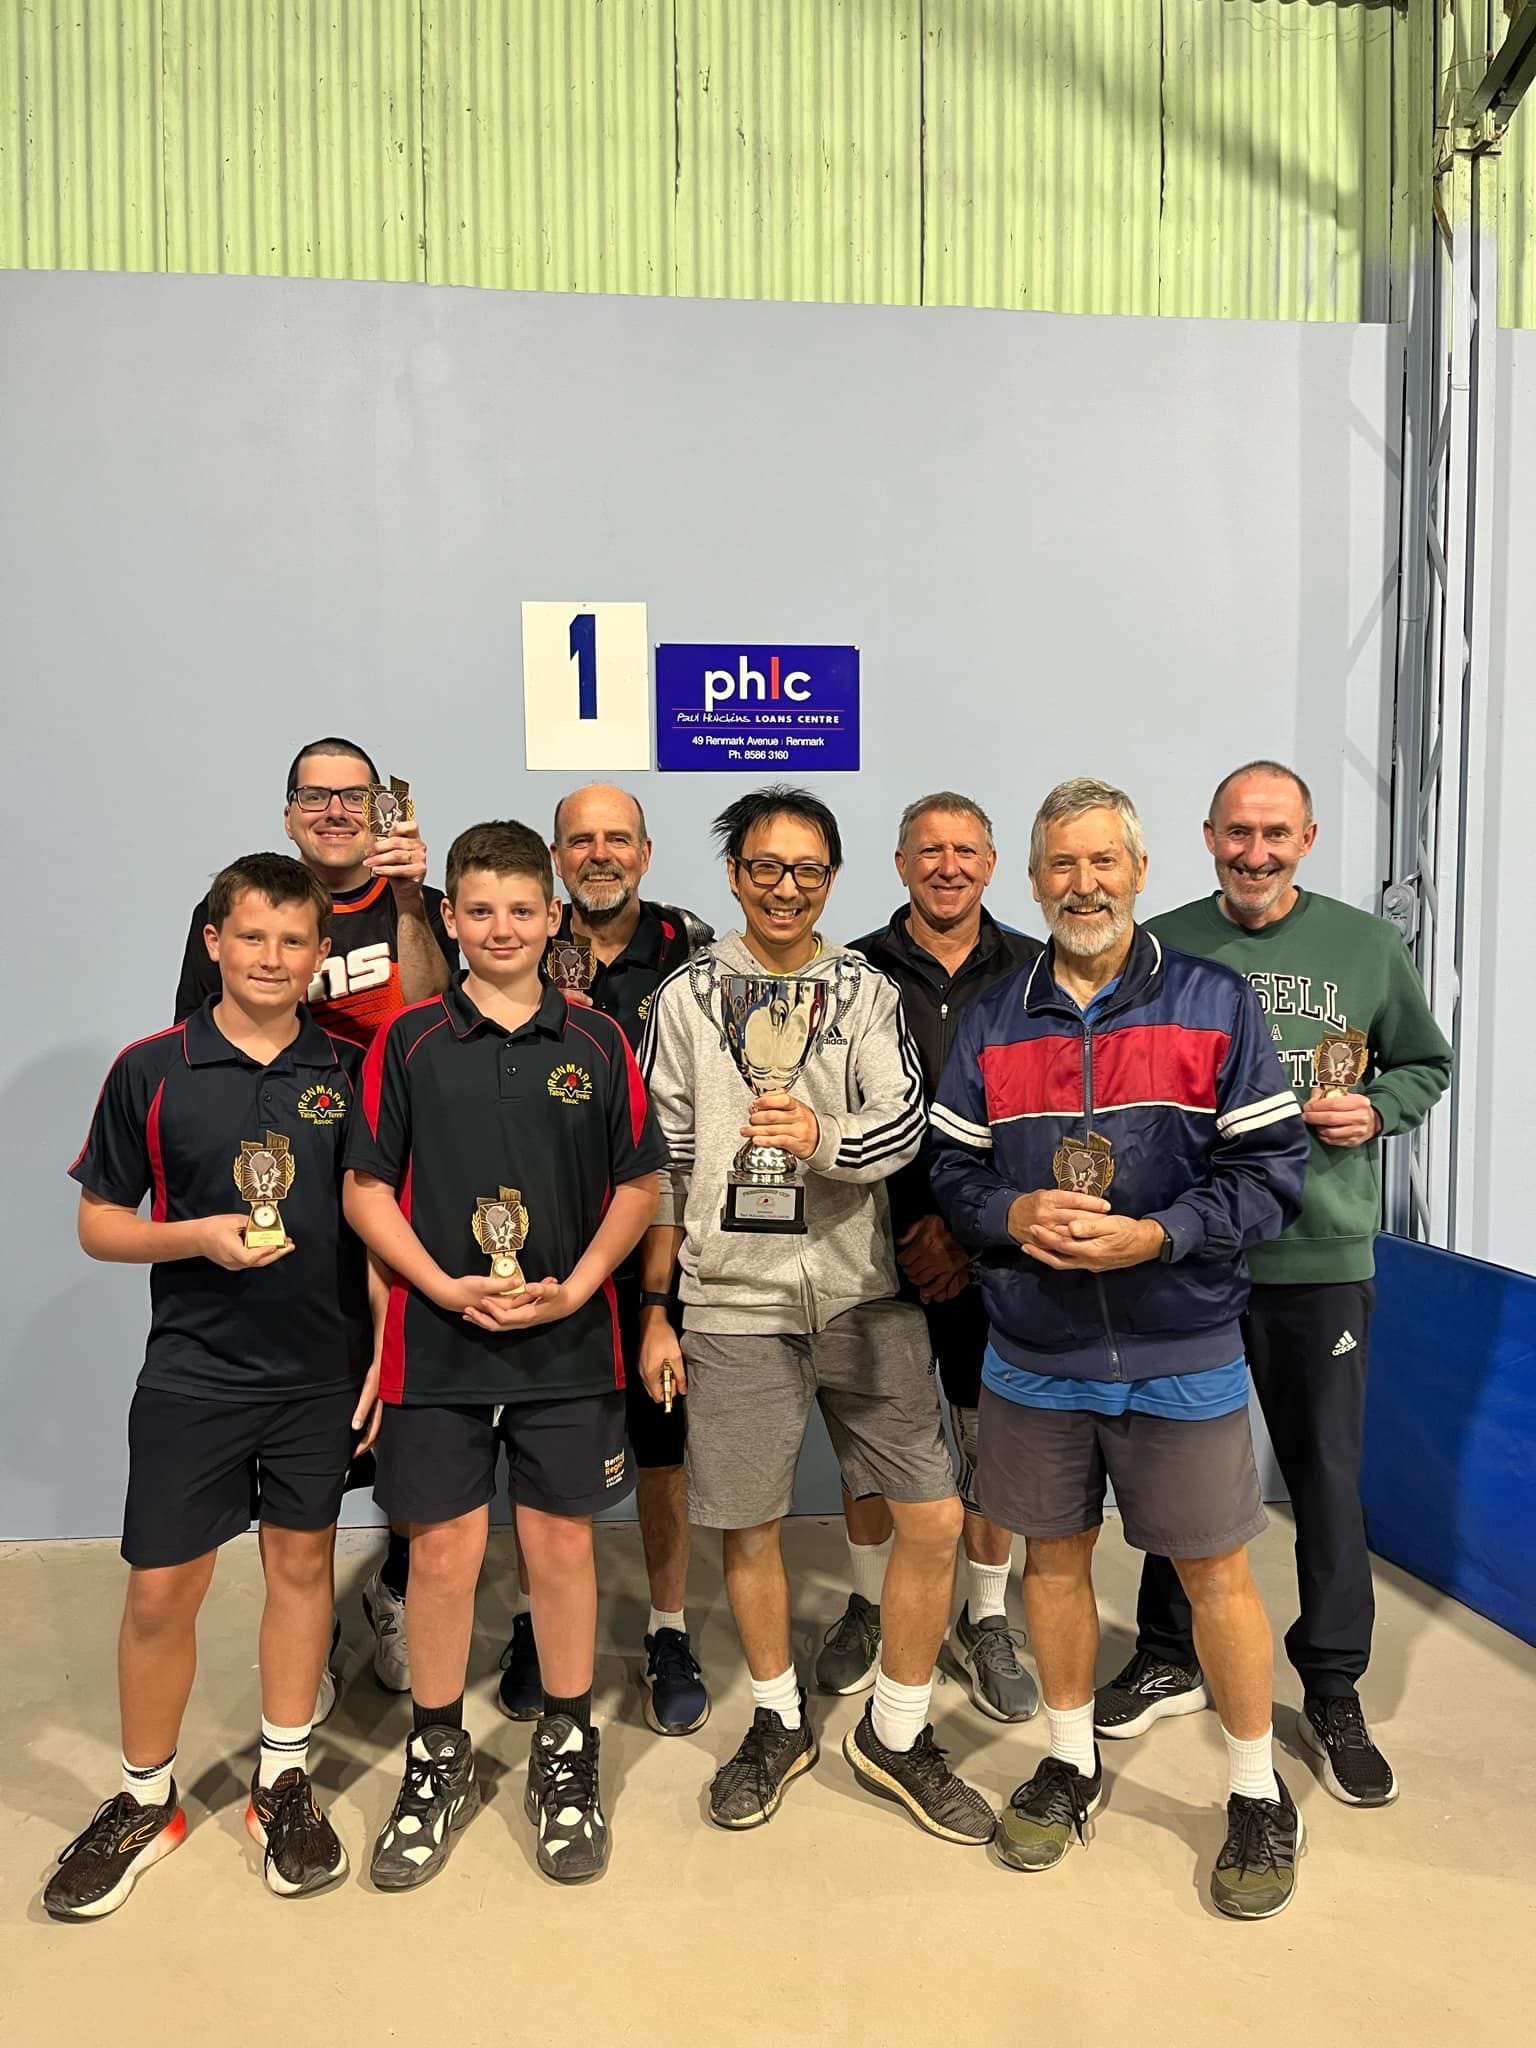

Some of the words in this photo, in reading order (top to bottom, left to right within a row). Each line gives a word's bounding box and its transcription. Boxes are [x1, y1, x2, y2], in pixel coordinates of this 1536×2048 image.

[569, 613, 598, 720] 1
[704, 655, 812, 713] phlc
[676, 712, 700, 722] Paul
[755, 714, 793, 723] LOANS
[797, 715, 840, 724] CENTRE
[691, 735, 705, 746] 49
[705, 735, 745, 746] Renmark
[746, 735, 779, 746] Avenue
[785, 736, 825, 747] Renmark
[728, 749, 743, 760] Ph.
[743, 749, 767, 760] 8586
[767, 750, 789, 760] 3160
[1241, 972, 1347, 1033] SELL
[823, 1036, 849, 1046] didas
[547, 1063, 593, 1091] RENMARK
[297, 1084, 346, 1110] RENMARK
